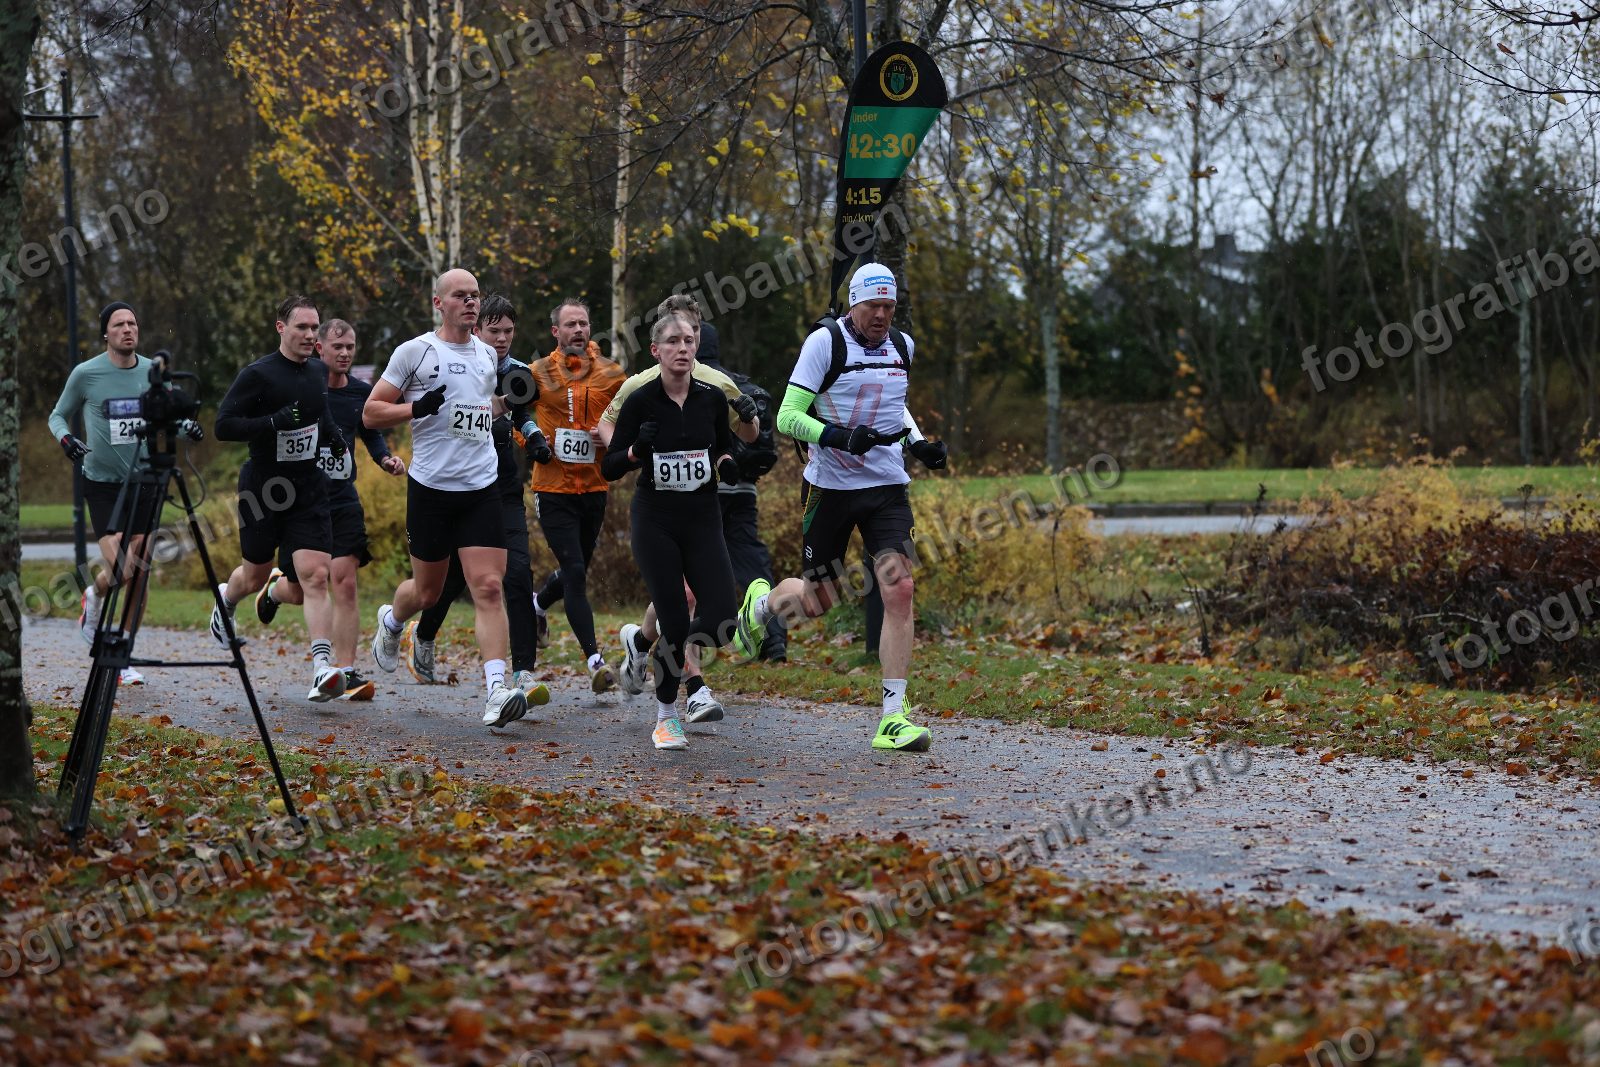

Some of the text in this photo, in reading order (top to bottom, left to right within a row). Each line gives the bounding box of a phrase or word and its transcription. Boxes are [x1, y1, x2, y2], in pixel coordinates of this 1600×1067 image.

[853, 112, 878, 122] Under
[849, 133, 916, 158] 42:30
[845, 187, 881, 205] 4:15
[453, 411, 490, 432] 2140
[286, 435, 313, 454] 357
[563, 439, 589, 456] 640
[320, 457, 344, 472] 393
[660, 461, 705, 482] 9118
